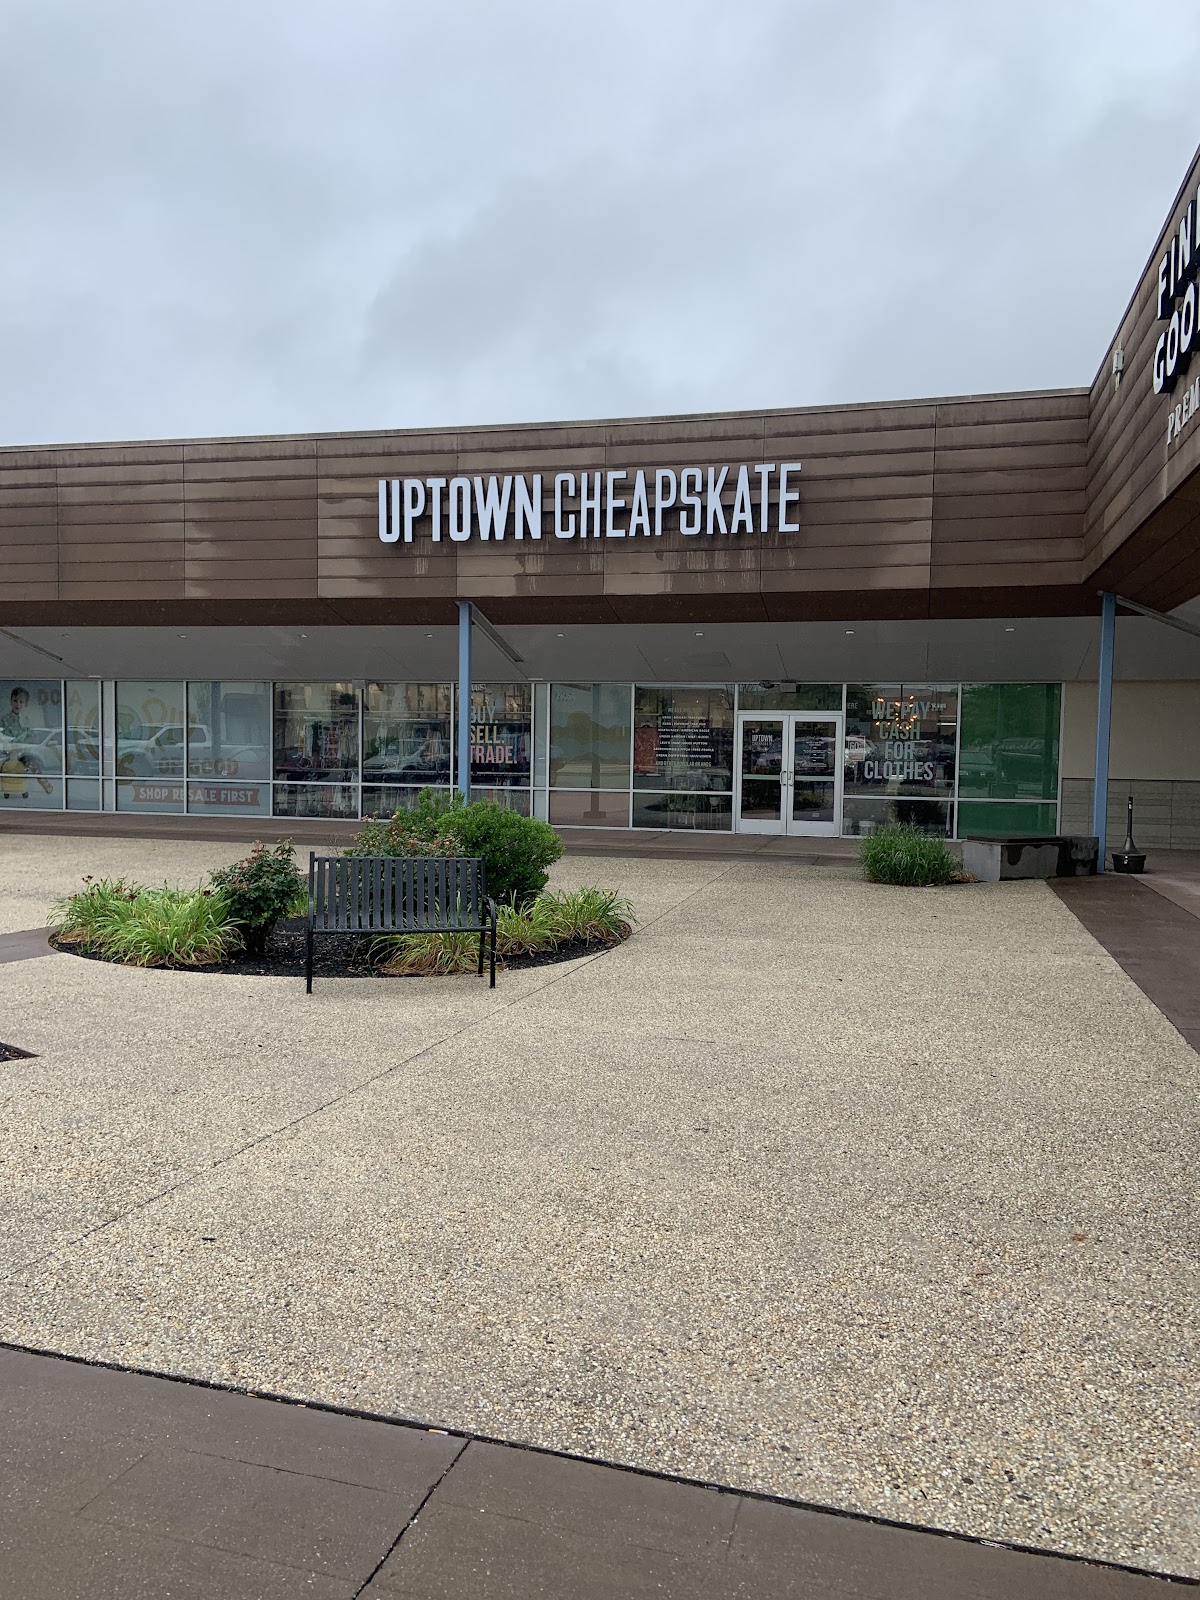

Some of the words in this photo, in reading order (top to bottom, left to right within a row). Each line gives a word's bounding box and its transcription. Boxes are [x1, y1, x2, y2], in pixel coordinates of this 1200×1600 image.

[1157, 185, 1200, 320] FIN
[1153, 282, 1200, 395] GOO
[378, 474, 542, 543] UPTOWN
[555, 463, 801, 539] CHEAPSKATE
[871, 701, 895, 719] WE
[901, 702, 930, 720] PAY
[752, 734, 774, 742] UPTOWN
[879, 721, 921, 740] CASH
[884, 741, 915, 760] FOR
[864, 761, 934, 781] CLOTHES
[139, 787, 168, 800] SHOP
[173, 788, 217, 802] RESALE
[221, 790, 253, 803] FIRST
